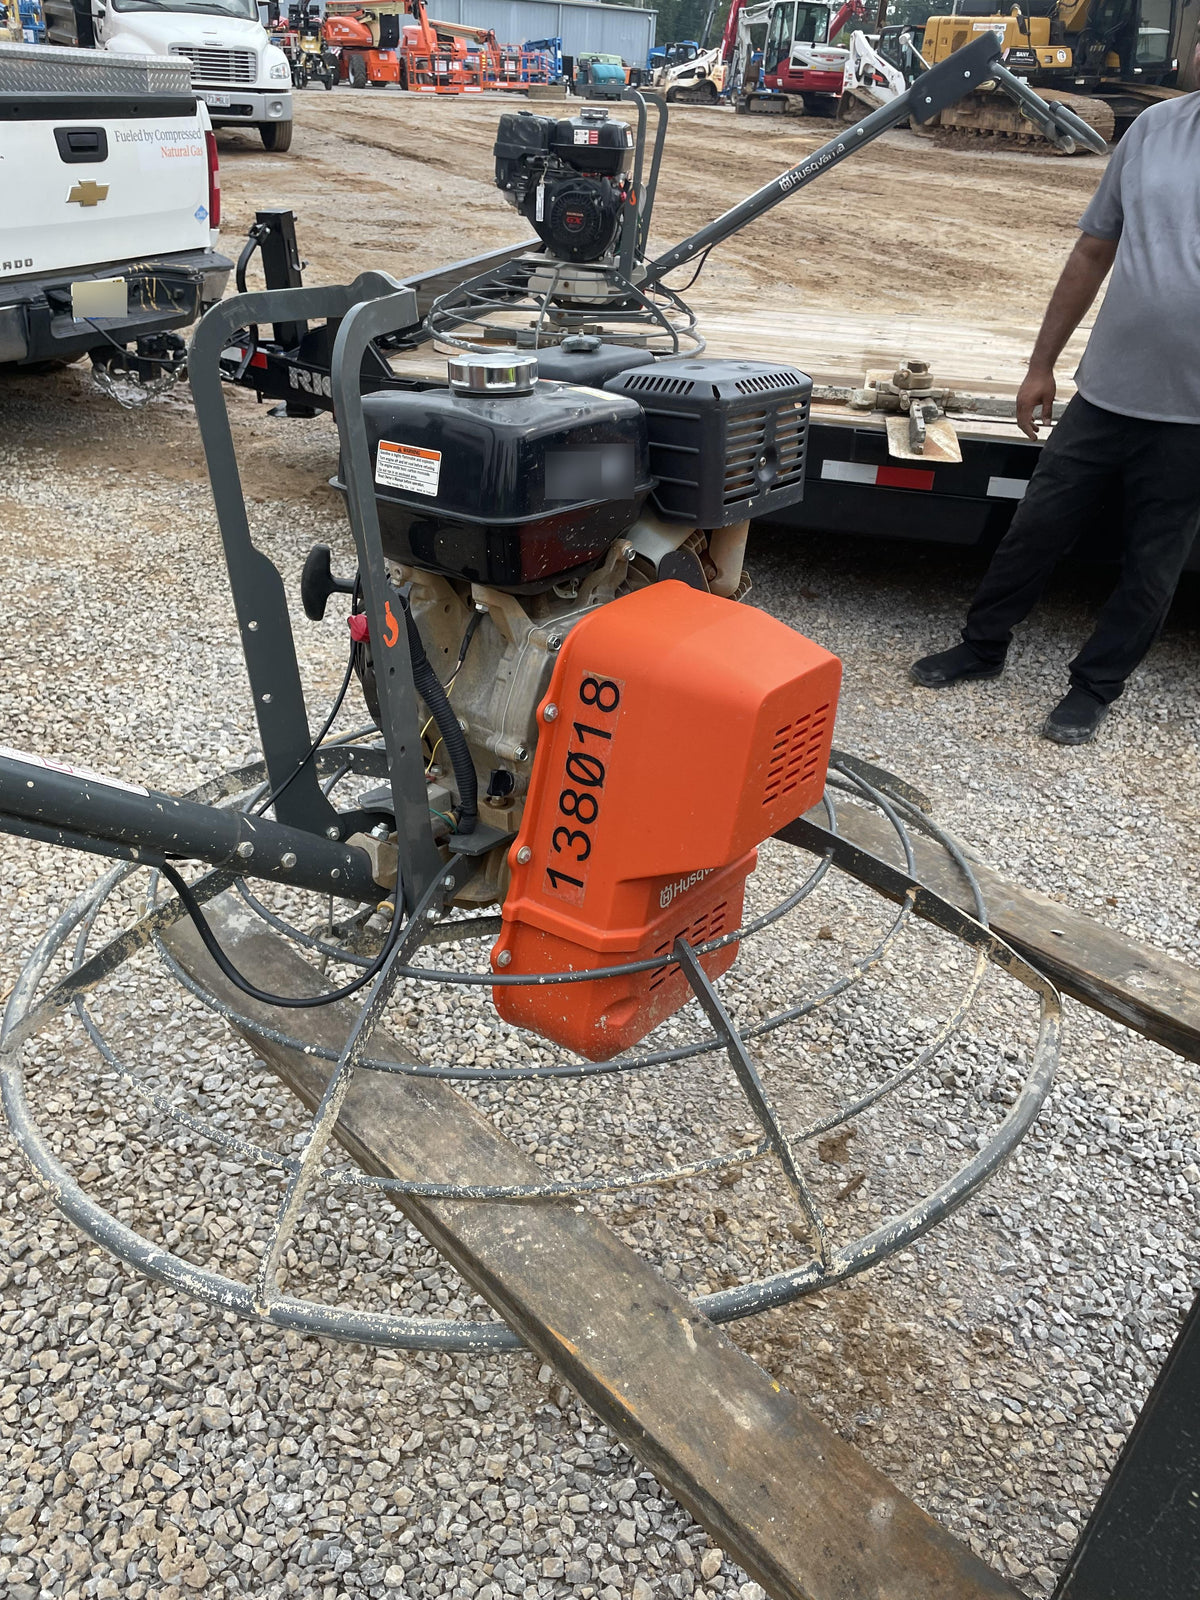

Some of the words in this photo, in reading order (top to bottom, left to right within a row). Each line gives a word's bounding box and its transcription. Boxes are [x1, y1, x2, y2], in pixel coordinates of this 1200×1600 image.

[114, 129, 143, 142] Fueled
[143, 129, 154, 144] by
[154, 128, 202, 143] Compressed
[160, 144, 190, 158] Natural
[190, 145, 203, 156] Gas
[546, 677, 621, 890] 138018
